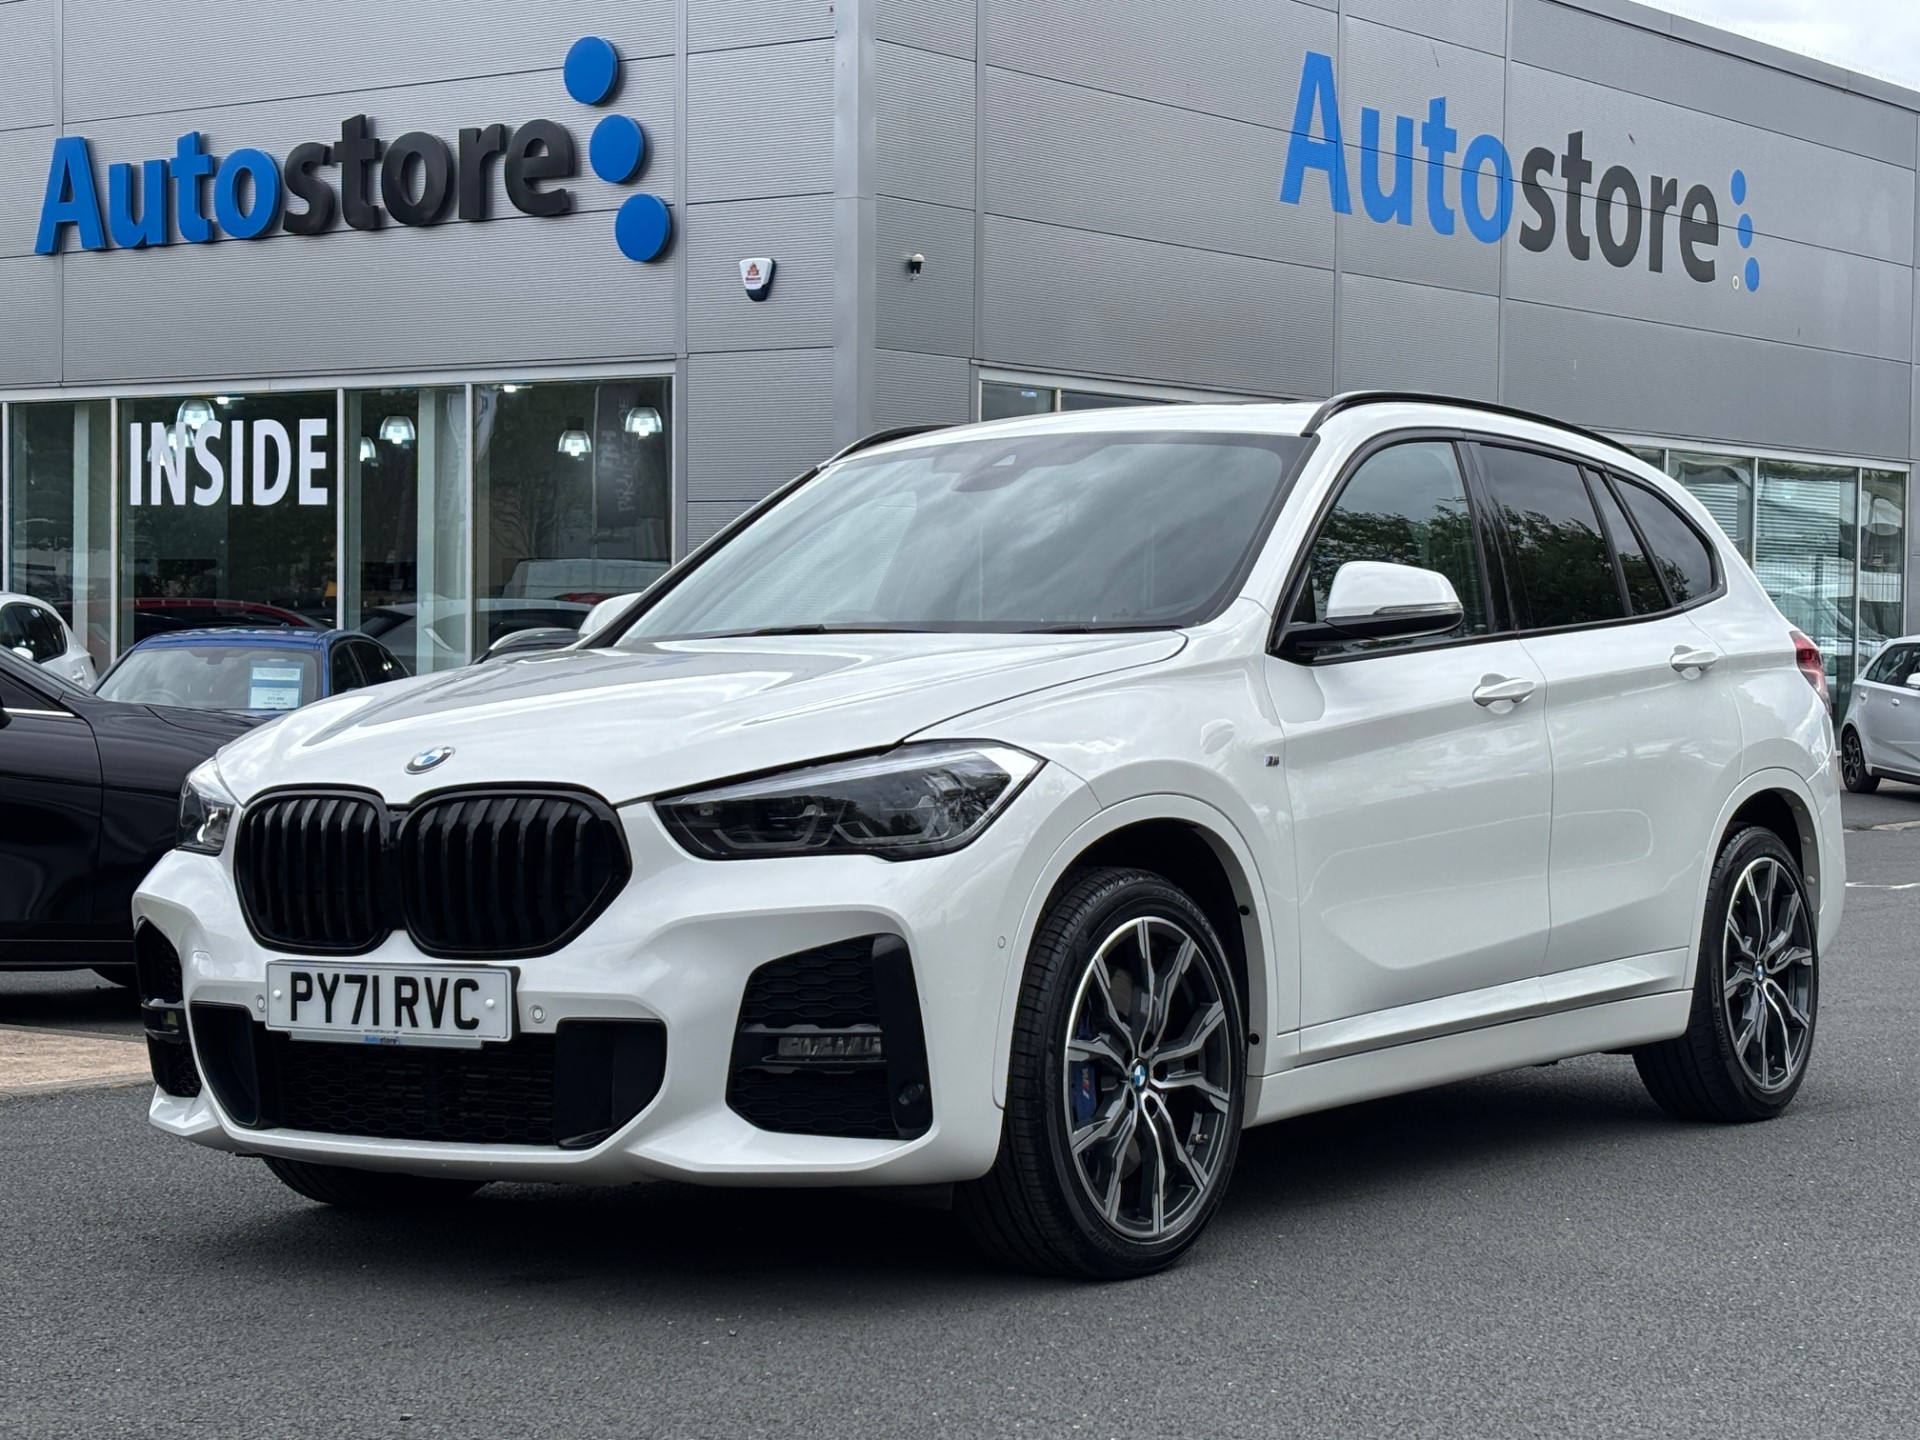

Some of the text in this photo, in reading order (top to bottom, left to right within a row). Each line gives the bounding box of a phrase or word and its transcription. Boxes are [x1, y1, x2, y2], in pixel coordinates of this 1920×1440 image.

[34, 113, 575, 256] Autostore
[1279, 50, 1720, 284] Autostore
[129, 417, 328, 507] INSIDE
[290, 971, 480, 1030] PY71 RVC
